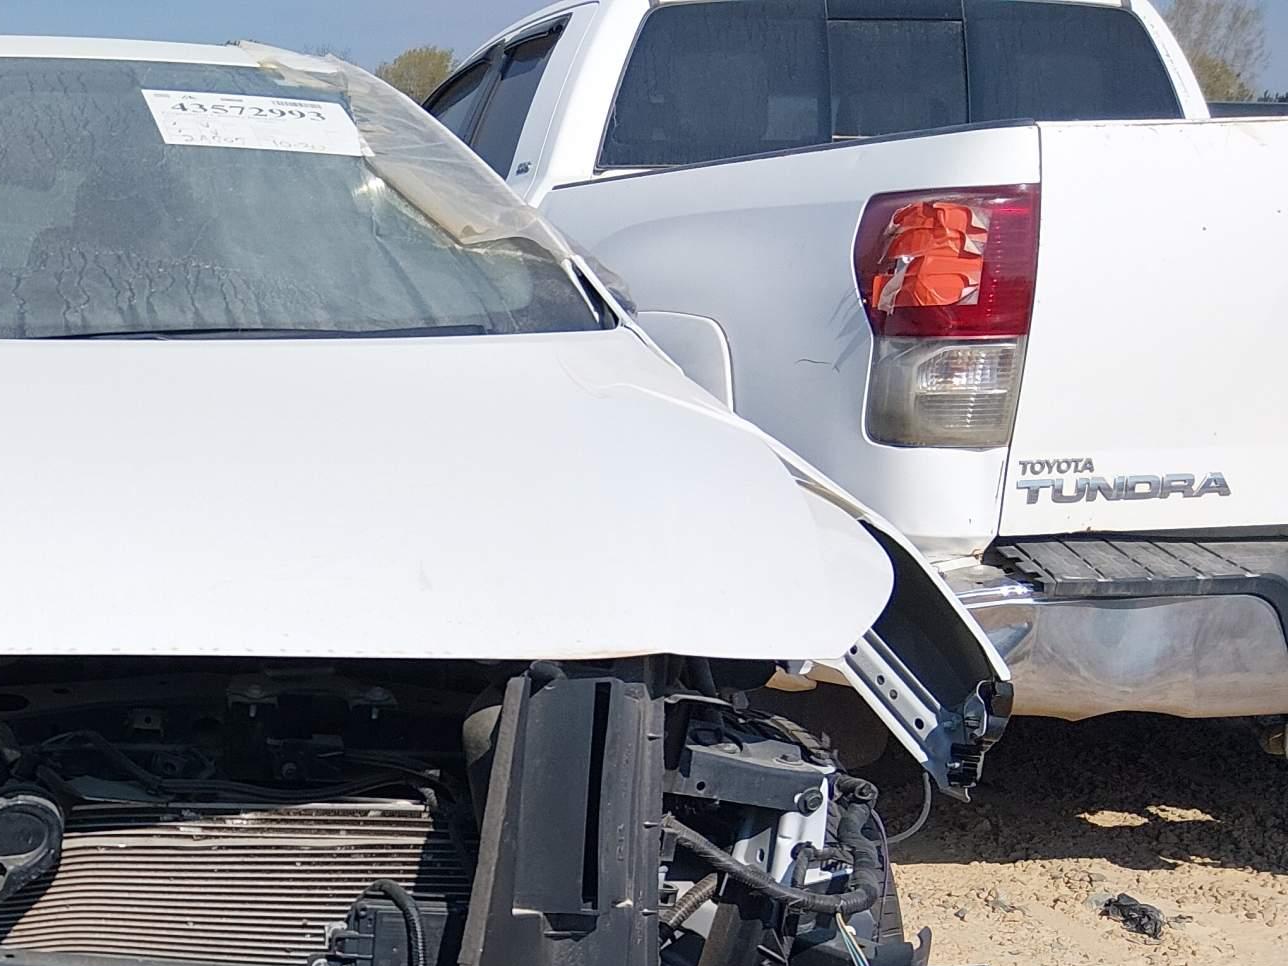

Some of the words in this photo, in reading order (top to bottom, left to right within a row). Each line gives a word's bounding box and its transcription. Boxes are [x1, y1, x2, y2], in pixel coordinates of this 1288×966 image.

[171, 102, 326, 122] 43572993
[1019, 458, 1095, 475] TOYOTA
[1016, 472, 1232, 505] TUNDRA
